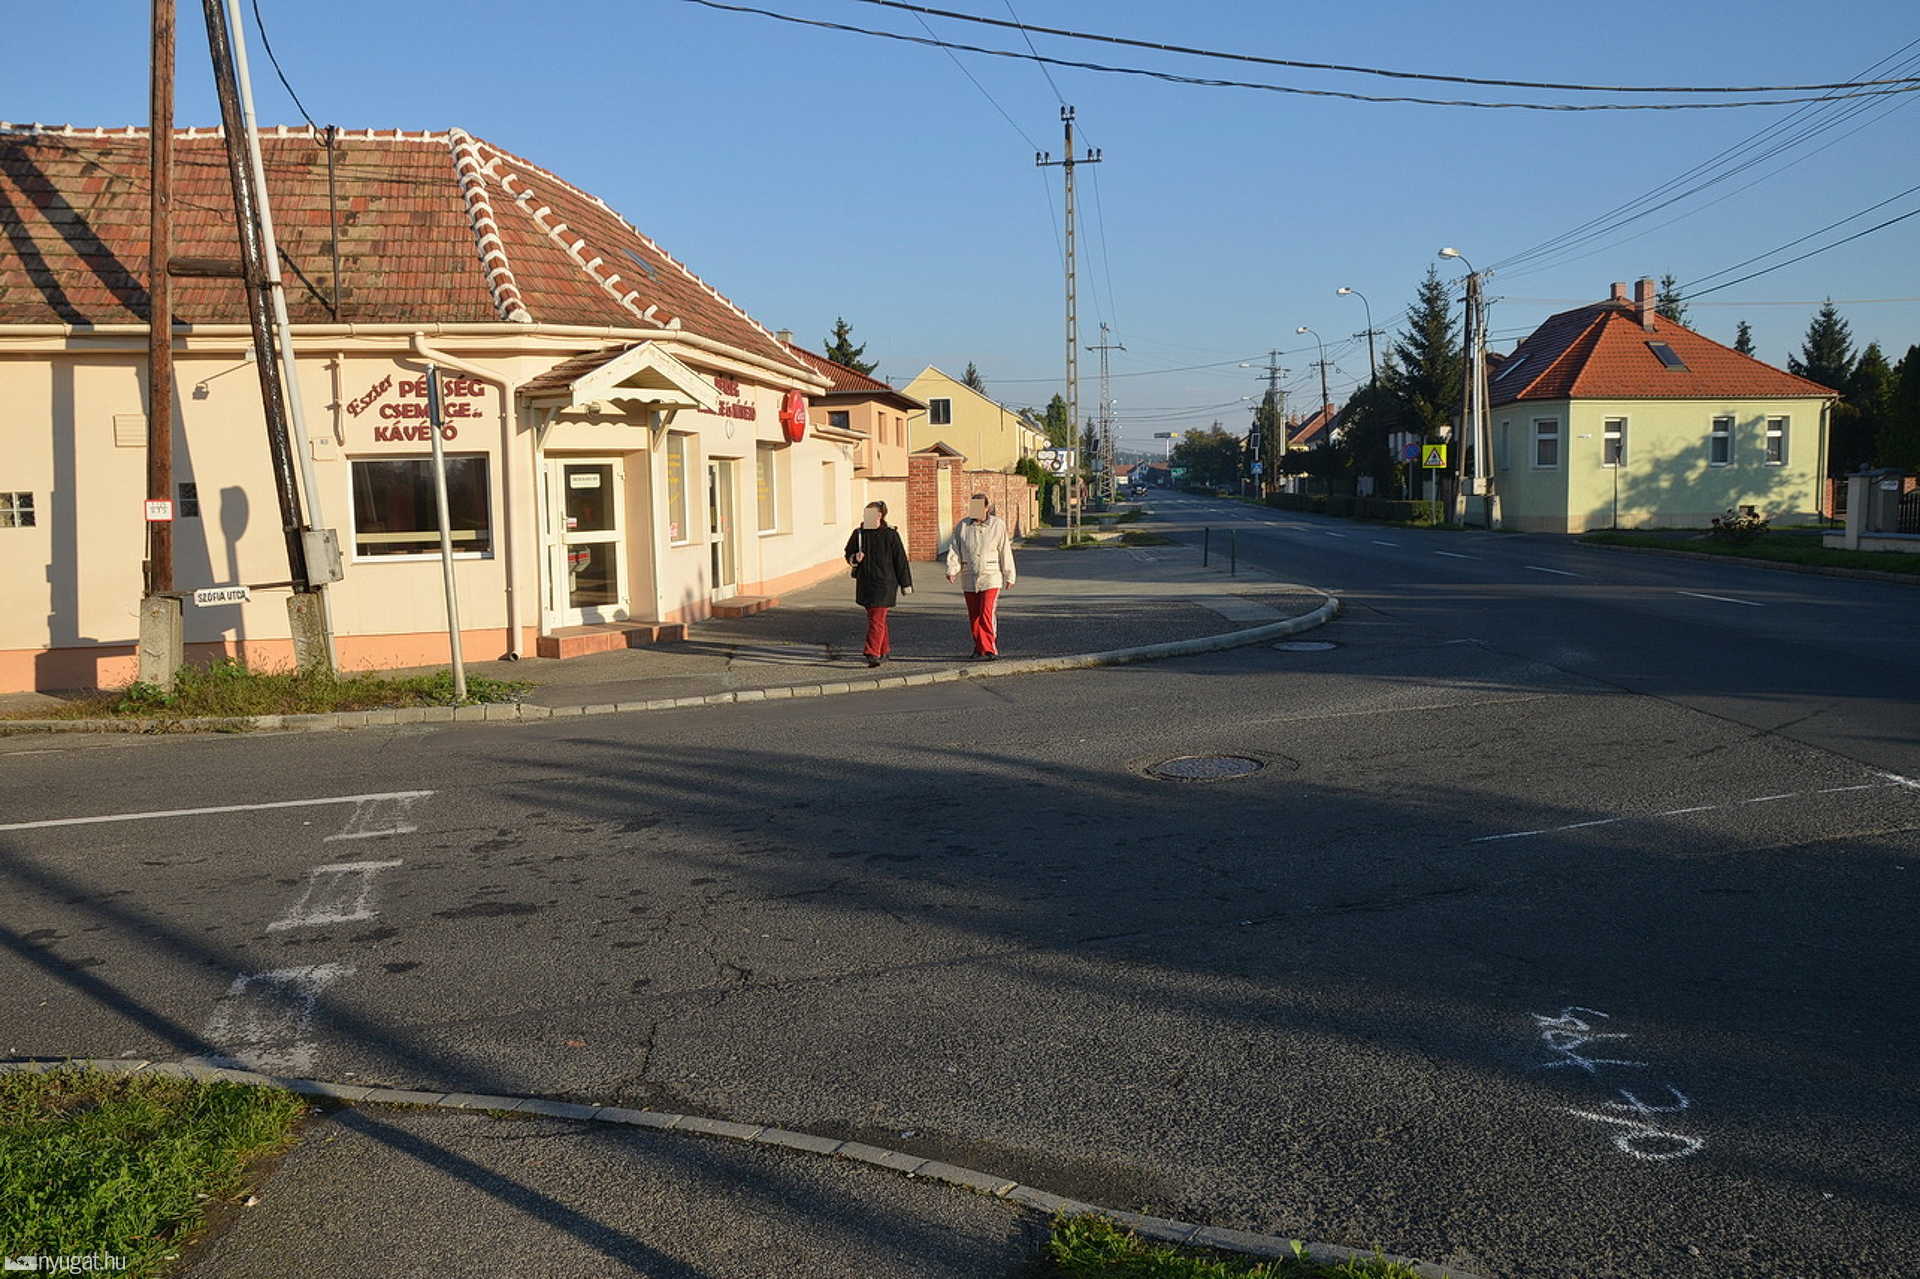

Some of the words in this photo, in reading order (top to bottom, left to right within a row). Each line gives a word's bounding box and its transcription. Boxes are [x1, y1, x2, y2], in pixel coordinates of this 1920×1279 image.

[346, 374, 393, 418] Eszter
[399, 374, 485, 398] PÉSÉG
[379, 402, 471, 419] CSEMGE
[374, 420, 458, 442] KÁVÉÓ
